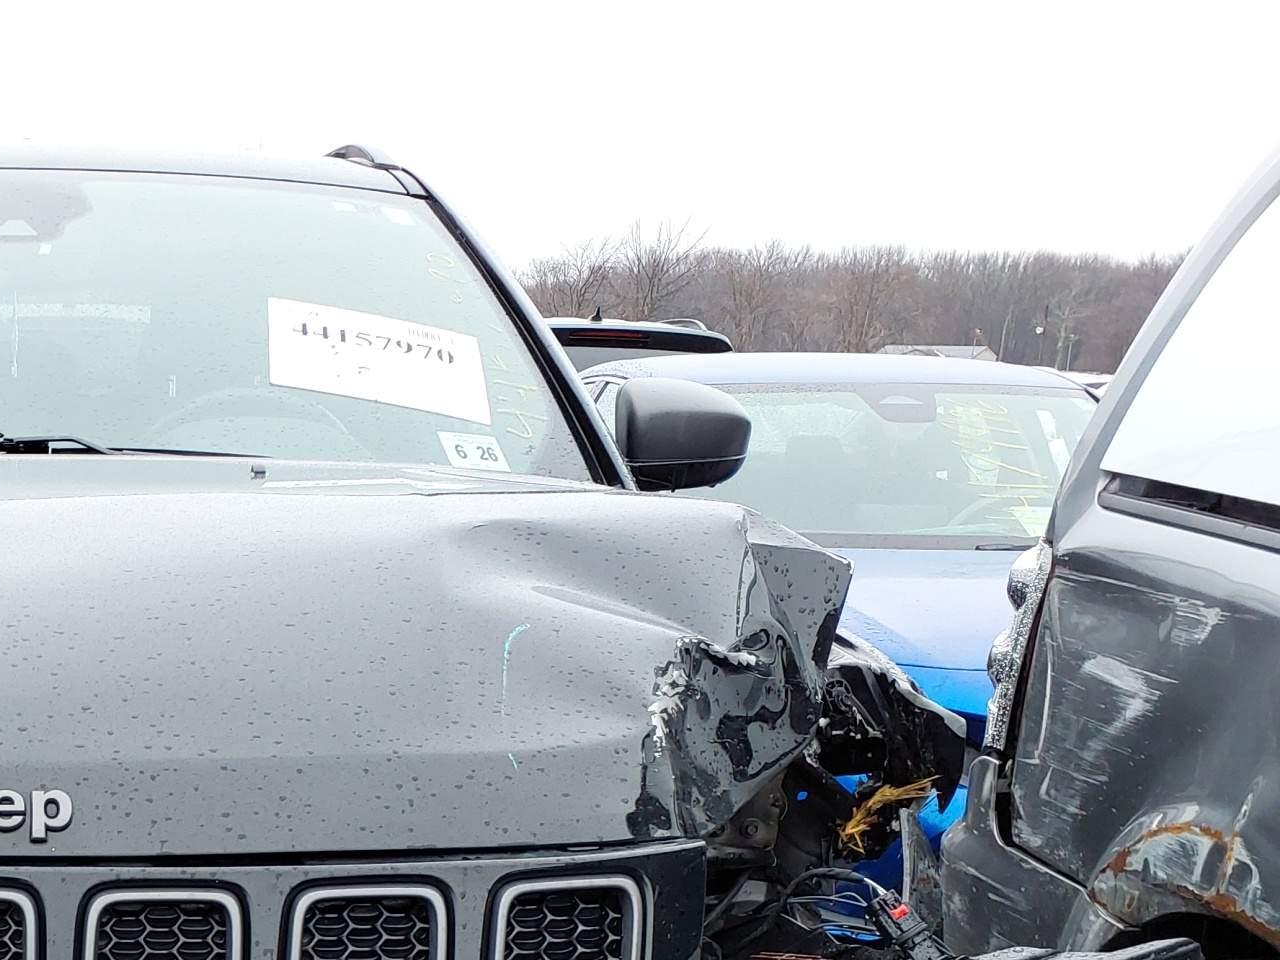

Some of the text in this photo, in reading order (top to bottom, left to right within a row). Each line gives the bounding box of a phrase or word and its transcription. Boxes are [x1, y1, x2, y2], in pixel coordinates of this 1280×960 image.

[292, 322, 455, 365] 44157970
[455, 444, 499, 462] 6 26
